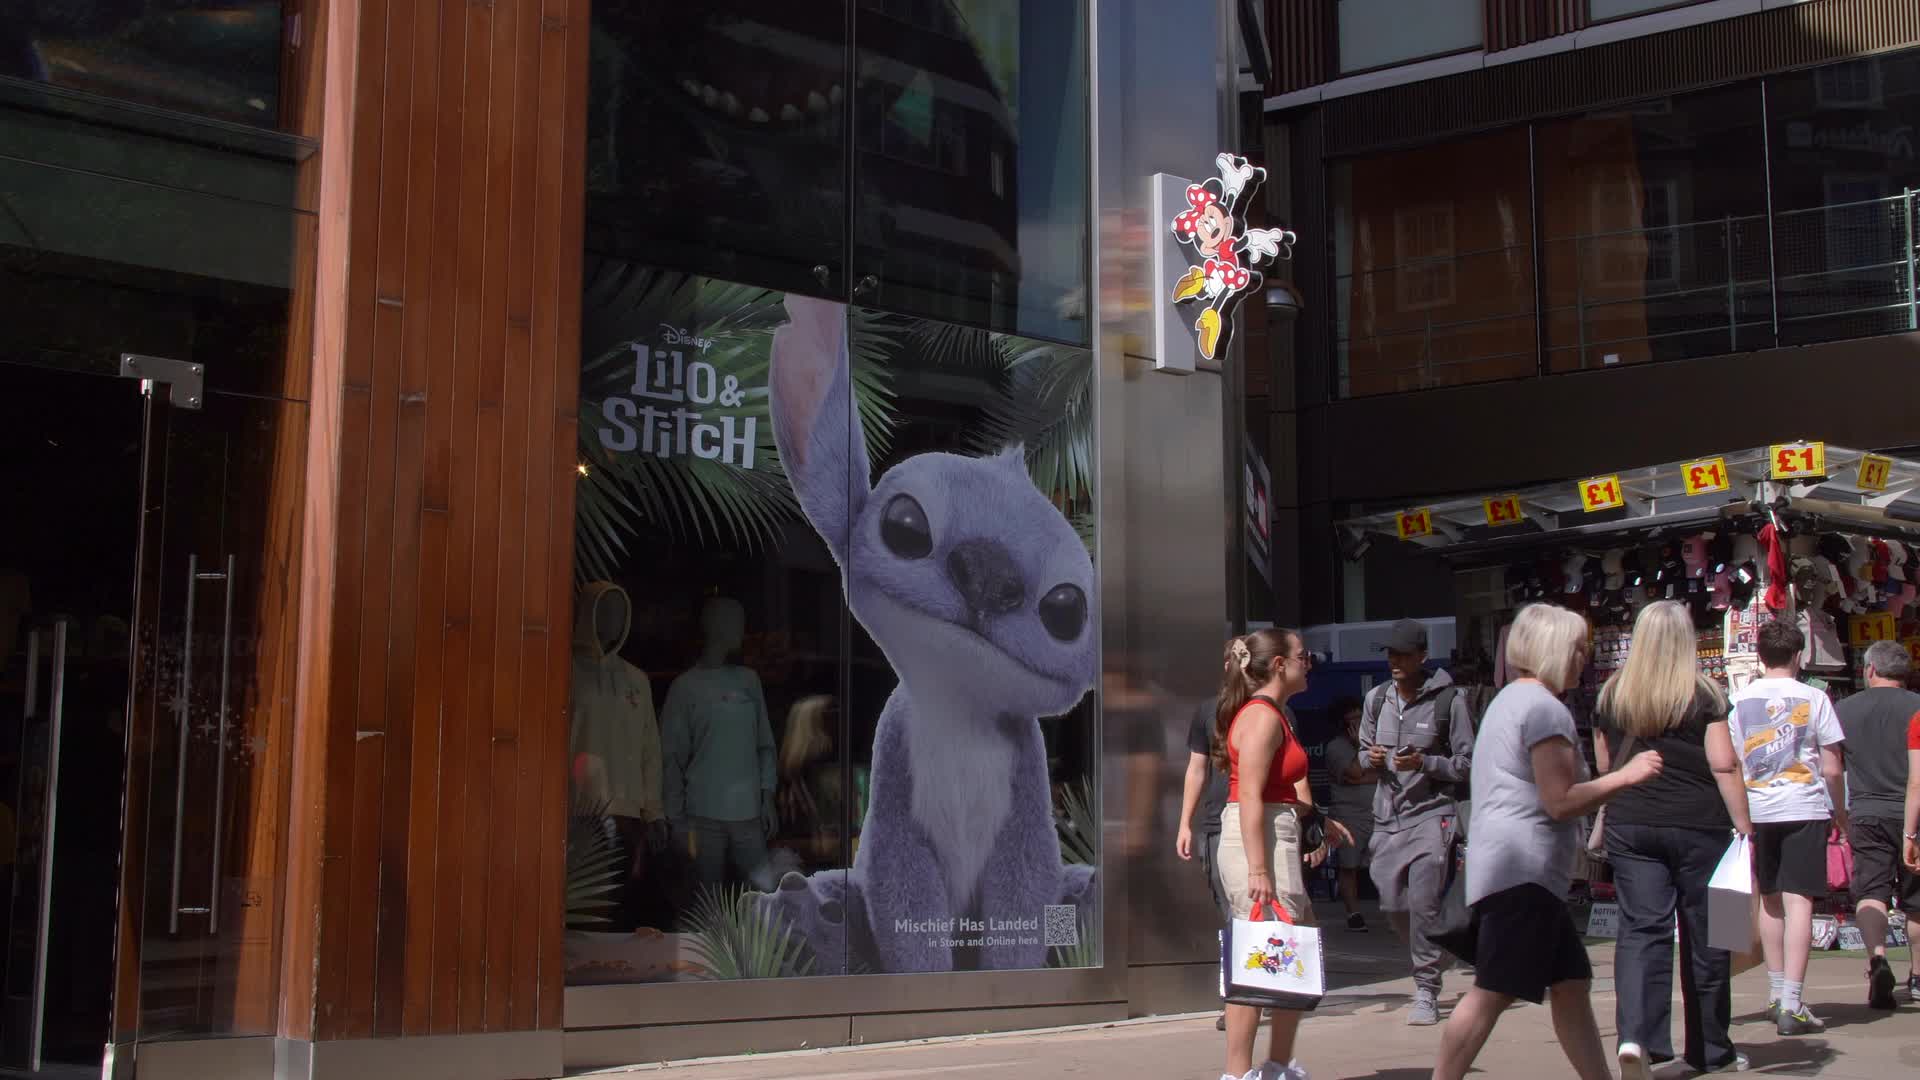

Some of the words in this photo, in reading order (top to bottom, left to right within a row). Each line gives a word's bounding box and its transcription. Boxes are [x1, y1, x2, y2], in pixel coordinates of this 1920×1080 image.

[719, 375, 746, 408] &
[1777, 448, 1815, 473] £1
[1689, 464, 1721, 490] £1
[1865, 463, 1884, 485] £1
[1586, 480, 1616, 506] £1
[1489, 499, 1513, 522] £1
[1402, 511, 1426, 534] £1
[1859, 619, 1884, 640] £1
[895, 917, 955, 933] Mischief
[959, 918, 985, 932] Has
[989, 916, 1038, 931] Landed
[940, 937, 965, 948] Store
[967, 937, 984, 947] and
[986, 936, 1016, 946] Online
[1018, 936, 1038, 945] here
